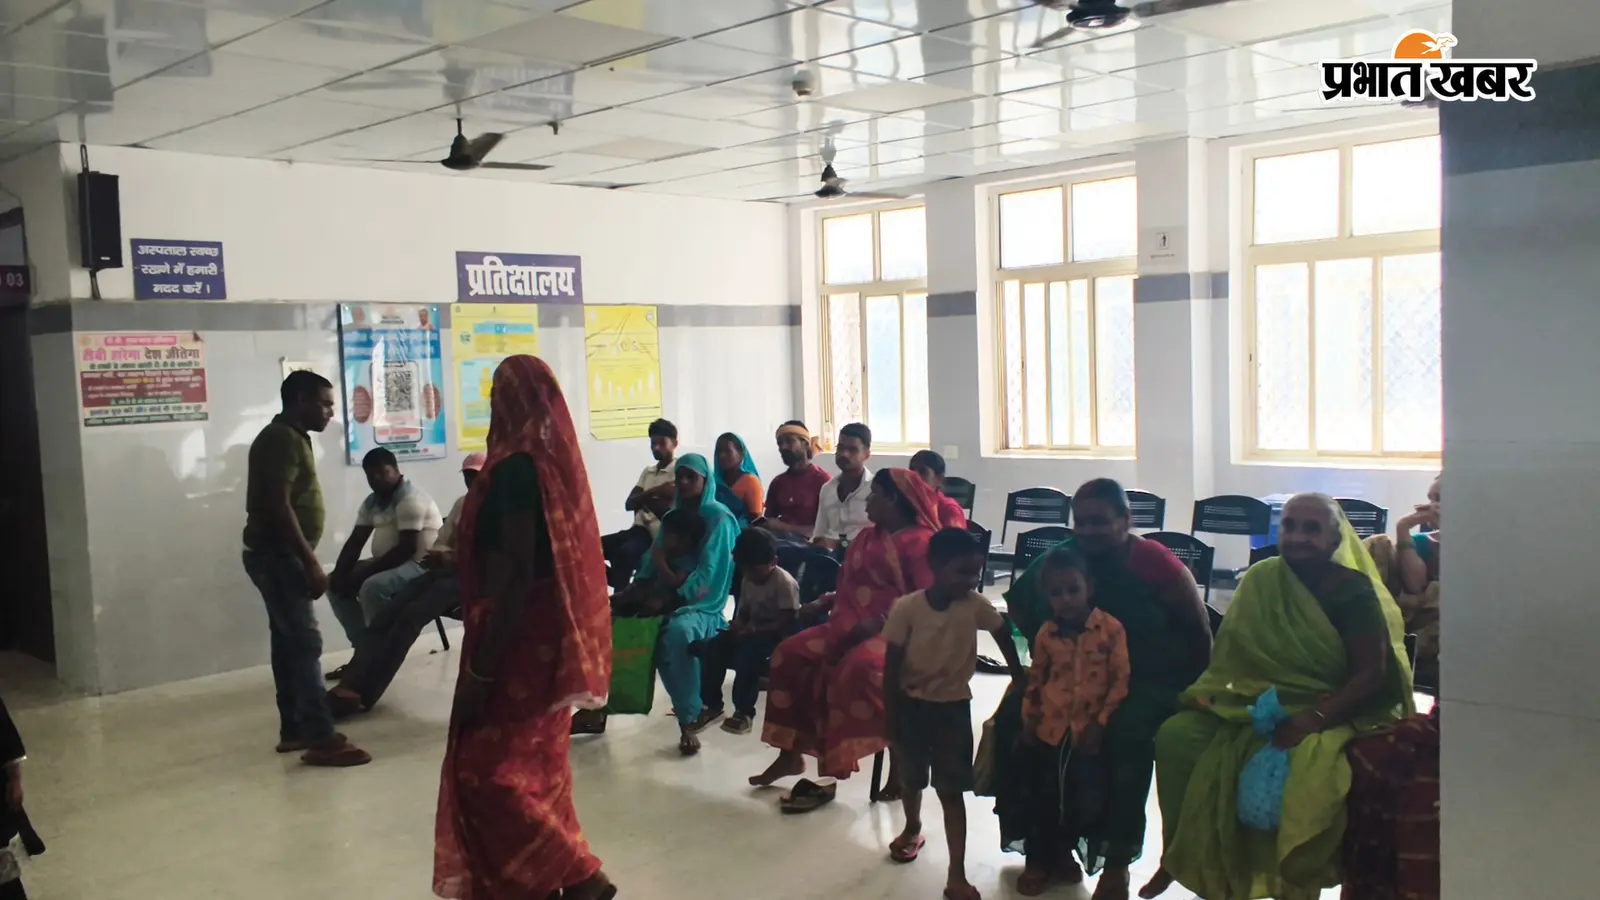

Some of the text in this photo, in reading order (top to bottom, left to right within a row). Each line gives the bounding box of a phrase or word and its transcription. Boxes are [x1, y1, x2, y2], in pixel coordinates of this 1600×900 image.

[137, 245, 219, 257] अस्पताल स्वच्छ
[173, 262, 185, 275] में
[186, 262, 218, 276] हमारी
[465, 255, 576, 296] प्रतिक्षालय
[6, 272, 24, 288] 03
[152, 283, 180, 294] मदद
[182, 281, 203, 294] करें
[144, 346, 162, 360] देश
[165, 345, 200, 360] जीतेगा
